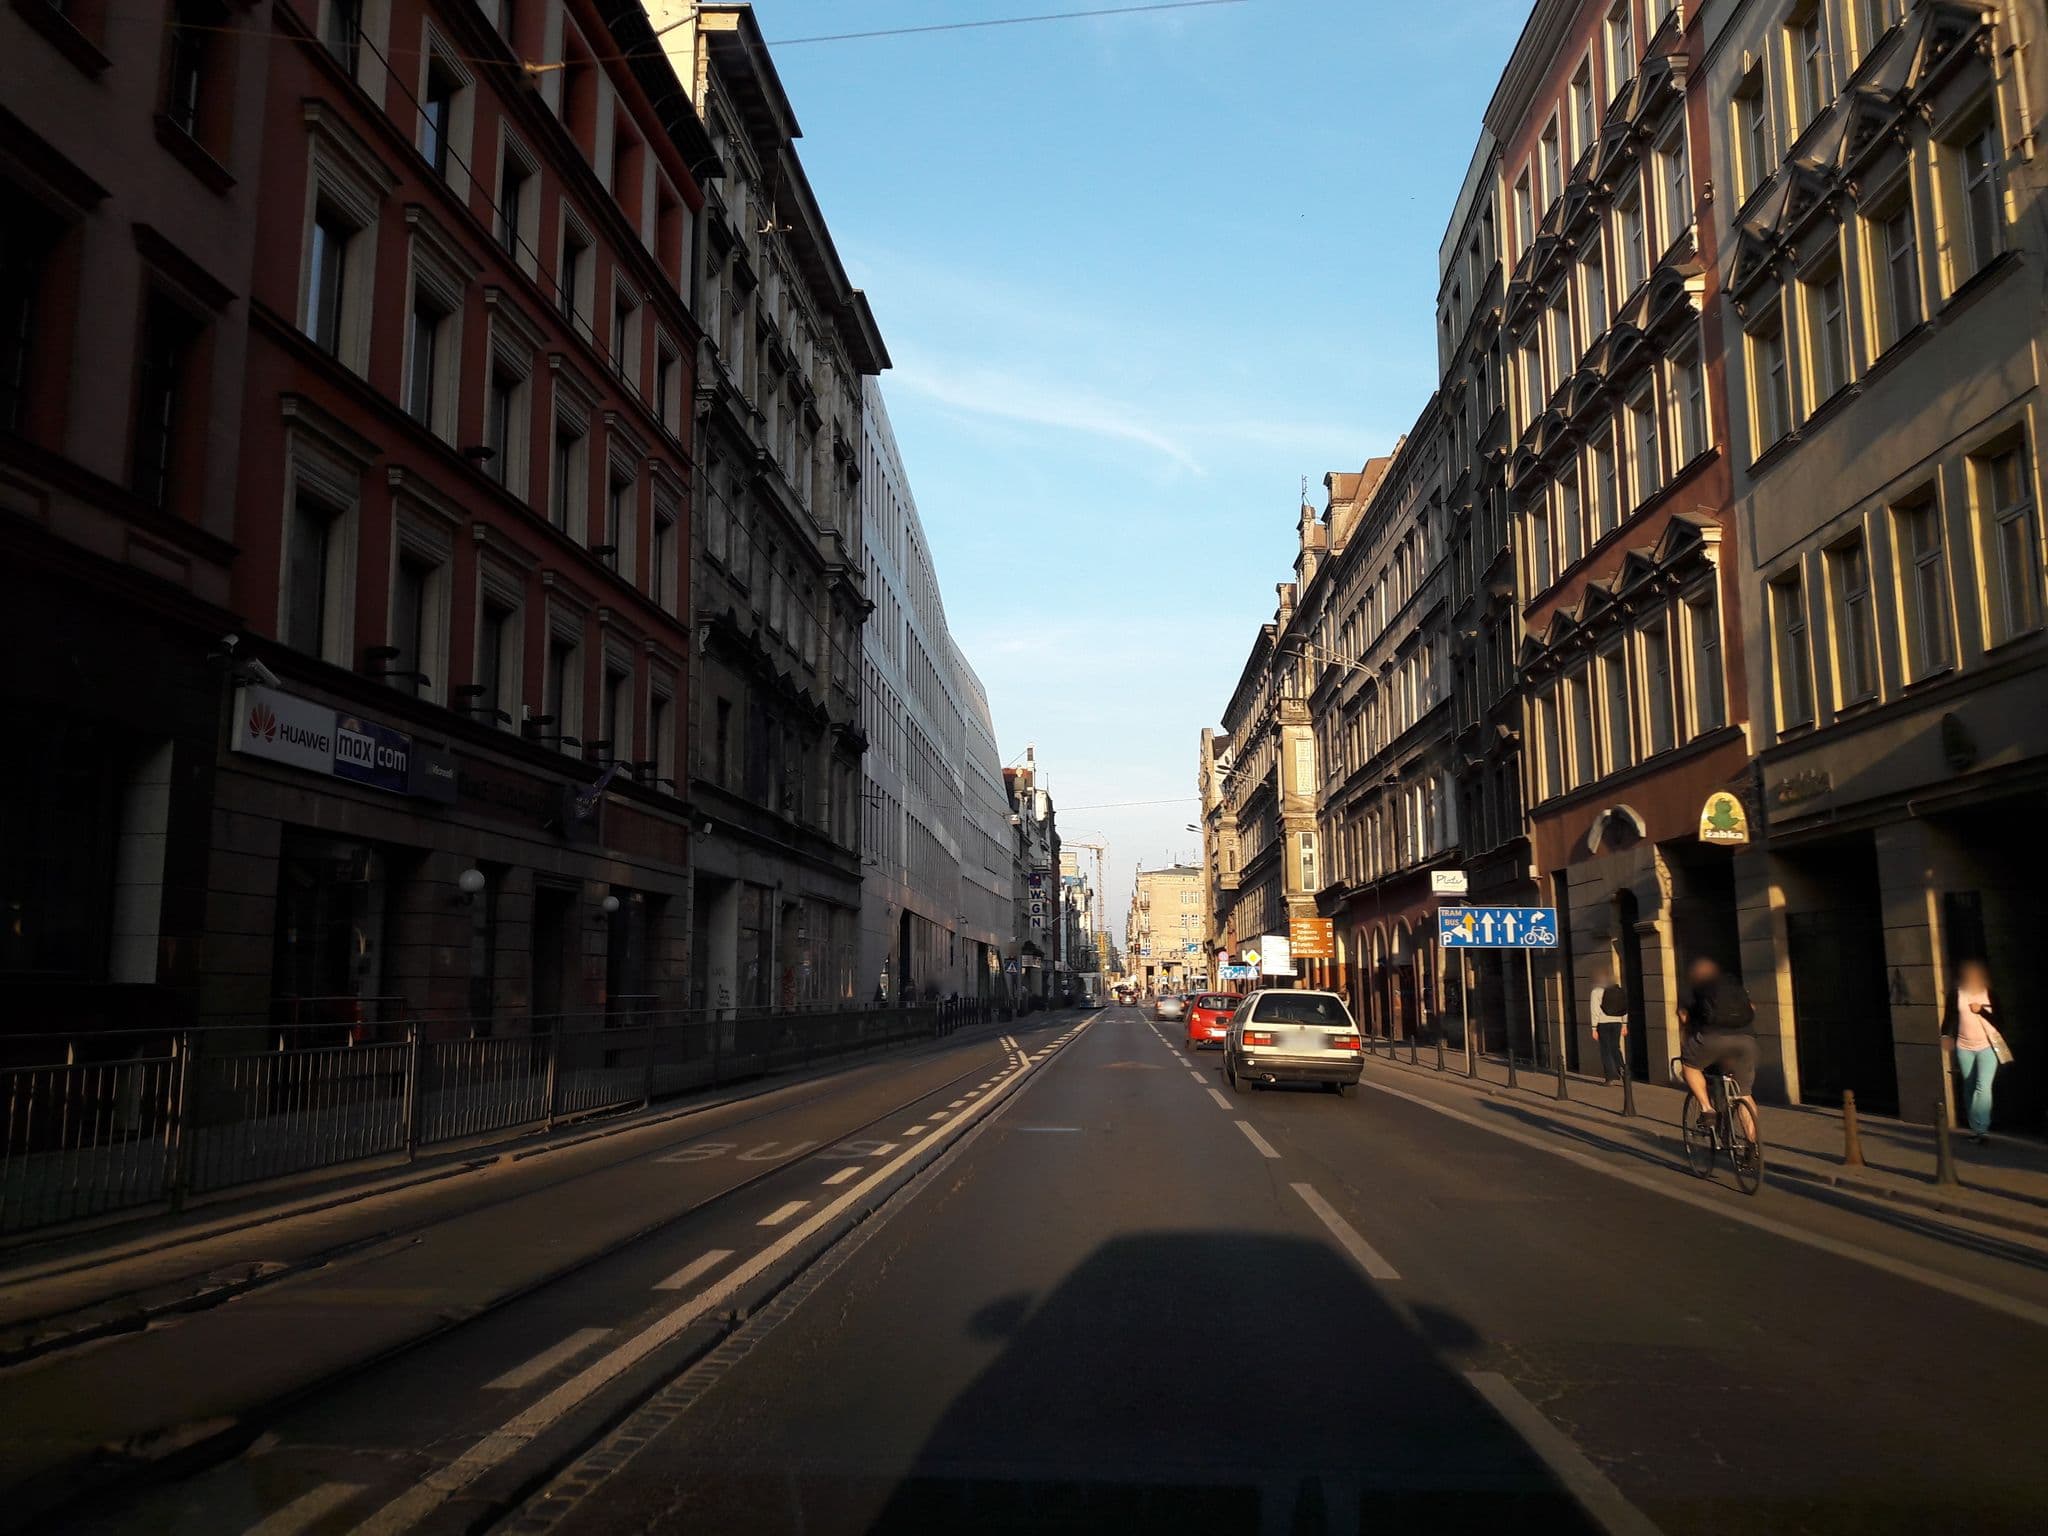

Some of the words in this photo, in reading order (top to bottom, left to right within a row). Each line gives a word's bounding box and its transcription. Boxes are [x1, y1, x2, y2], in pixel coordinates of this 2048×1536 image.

[280, 723, 330, 753] HUAWEI
[1705, 829, 1744, 840] żabka
[1030, 890, 1041, 928] WGN
[1443, 935, 1453, 945] P
[654, 1142, 891, 1162] BUS
